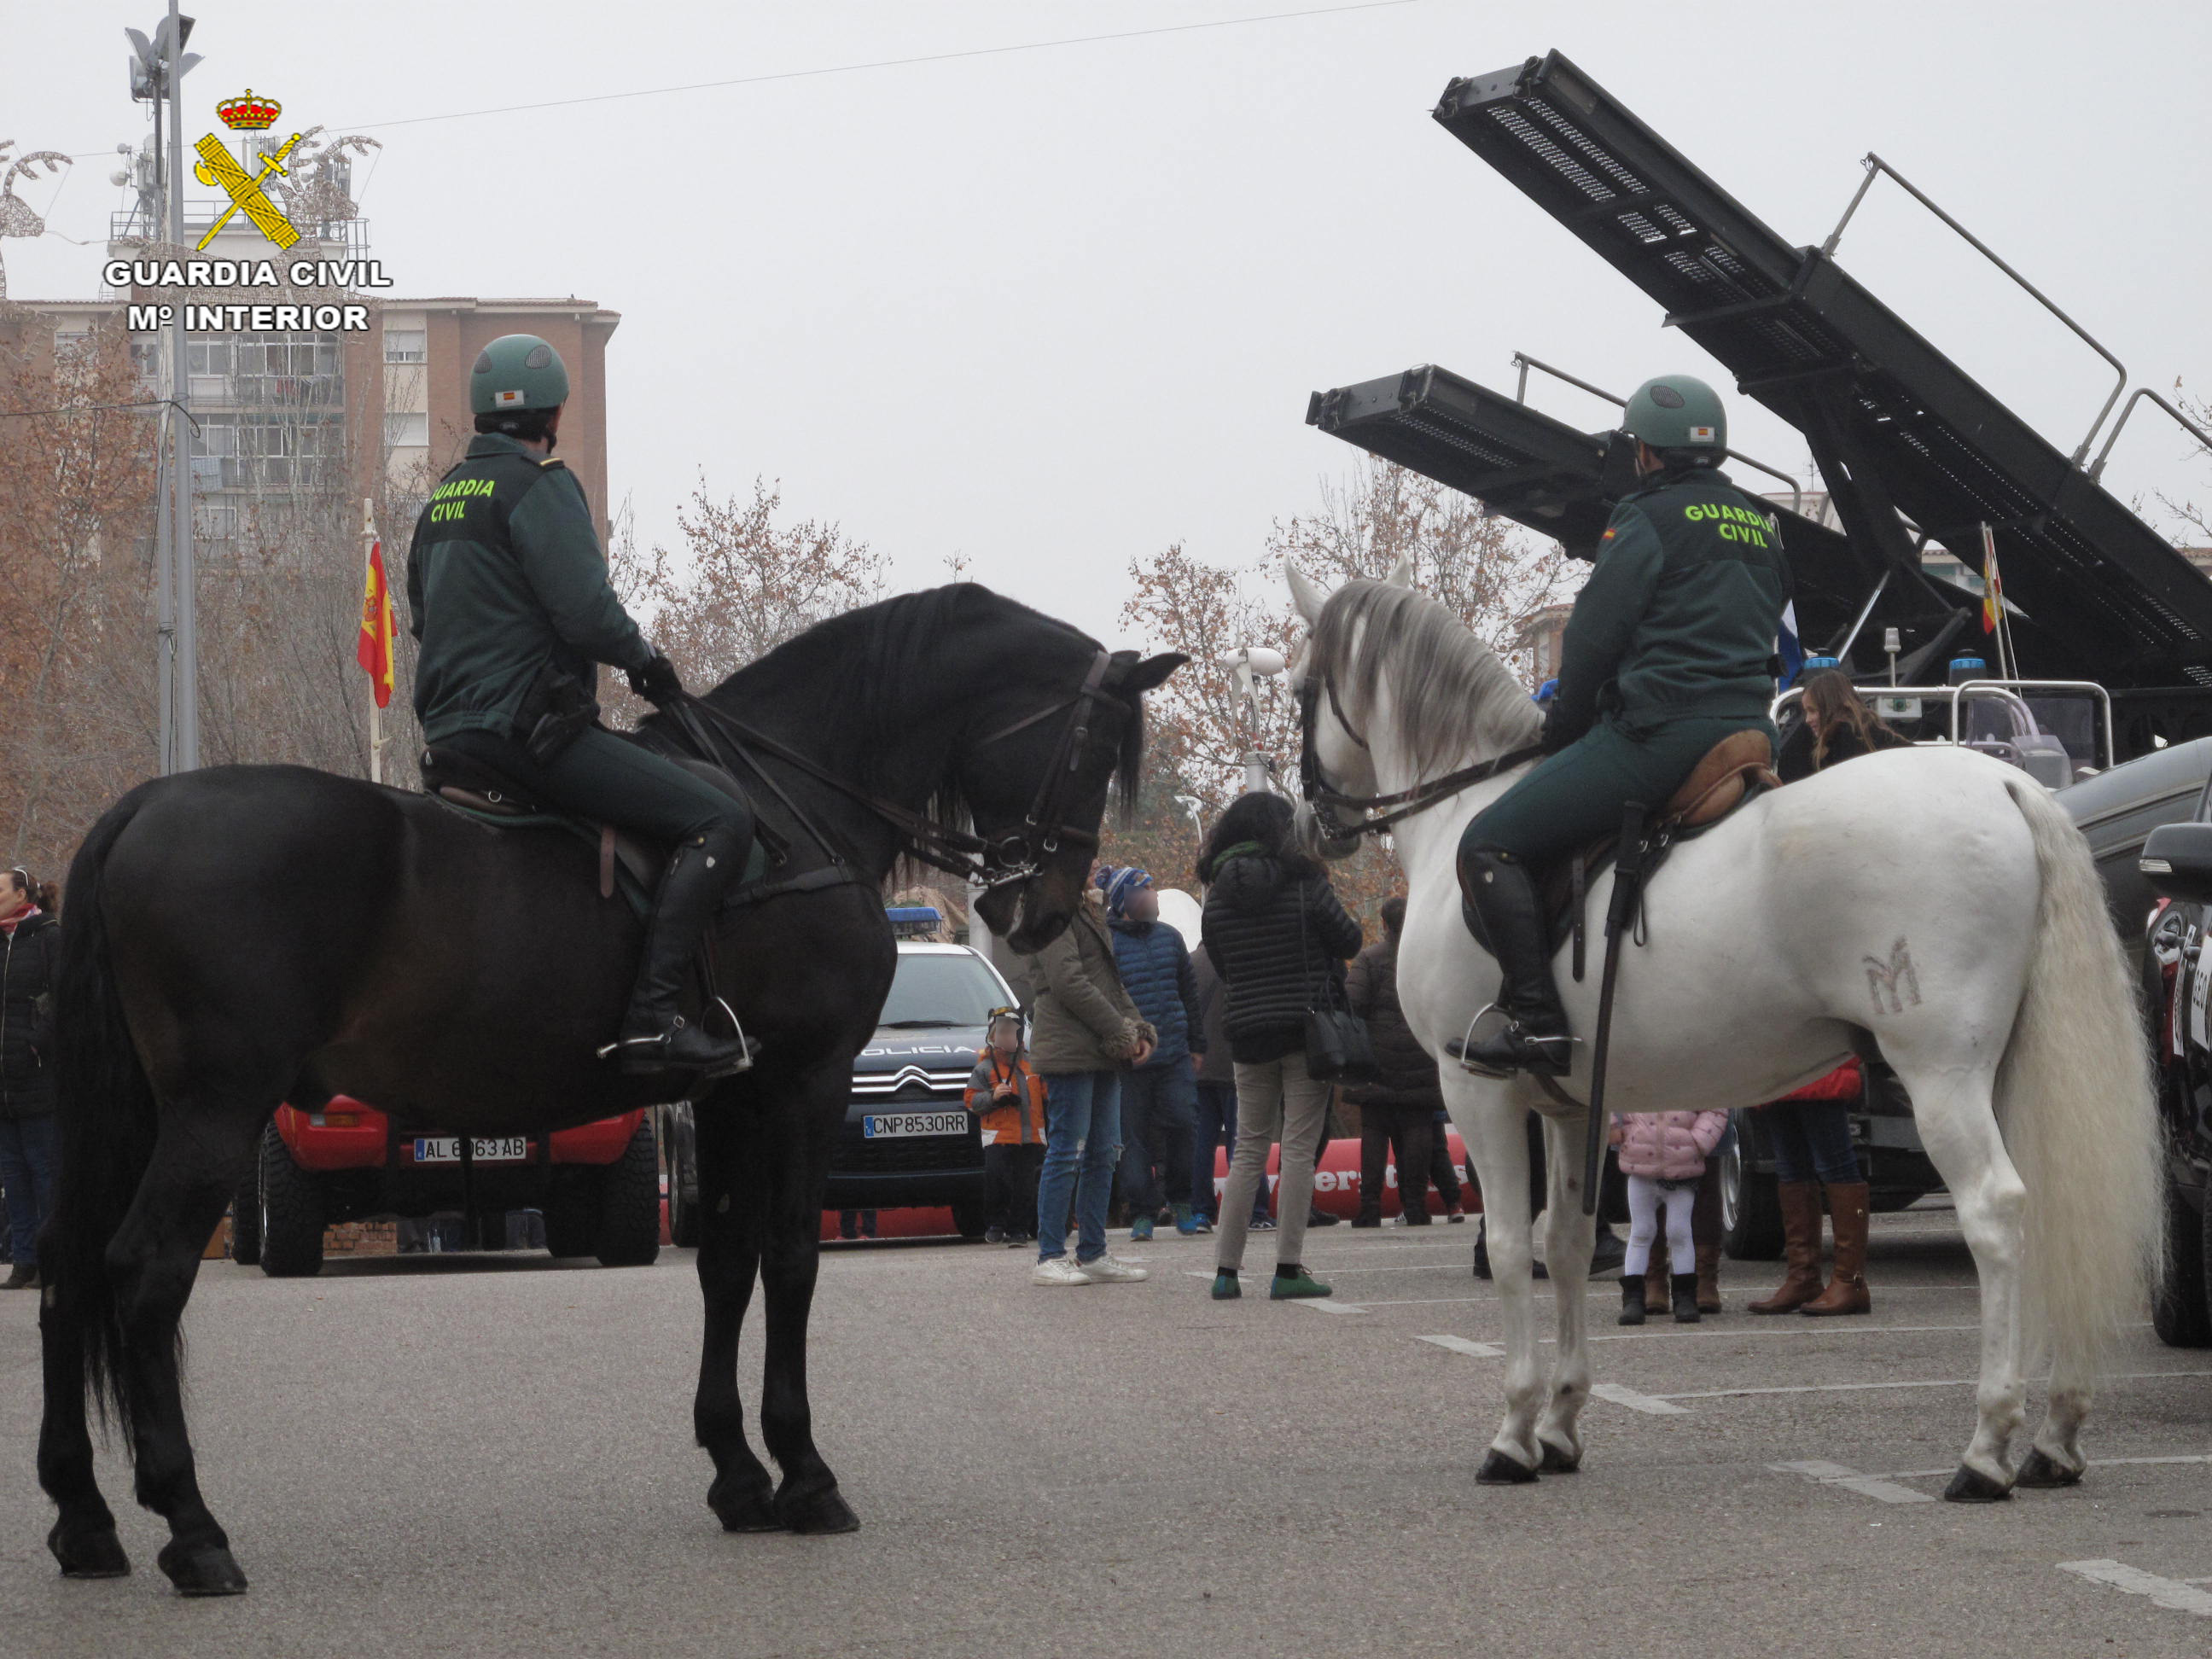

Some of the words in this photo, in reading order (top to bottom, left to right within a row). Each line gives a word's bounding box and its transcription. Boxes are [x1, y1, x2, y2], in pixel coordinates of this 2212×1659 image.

[431, 500, 466, 522] CIVIL
[1720, 522, 1768, 549] CIVIL
[860, 1045, 976, 1057] OLICIA
[451, 1139, 498, 1157] 663
